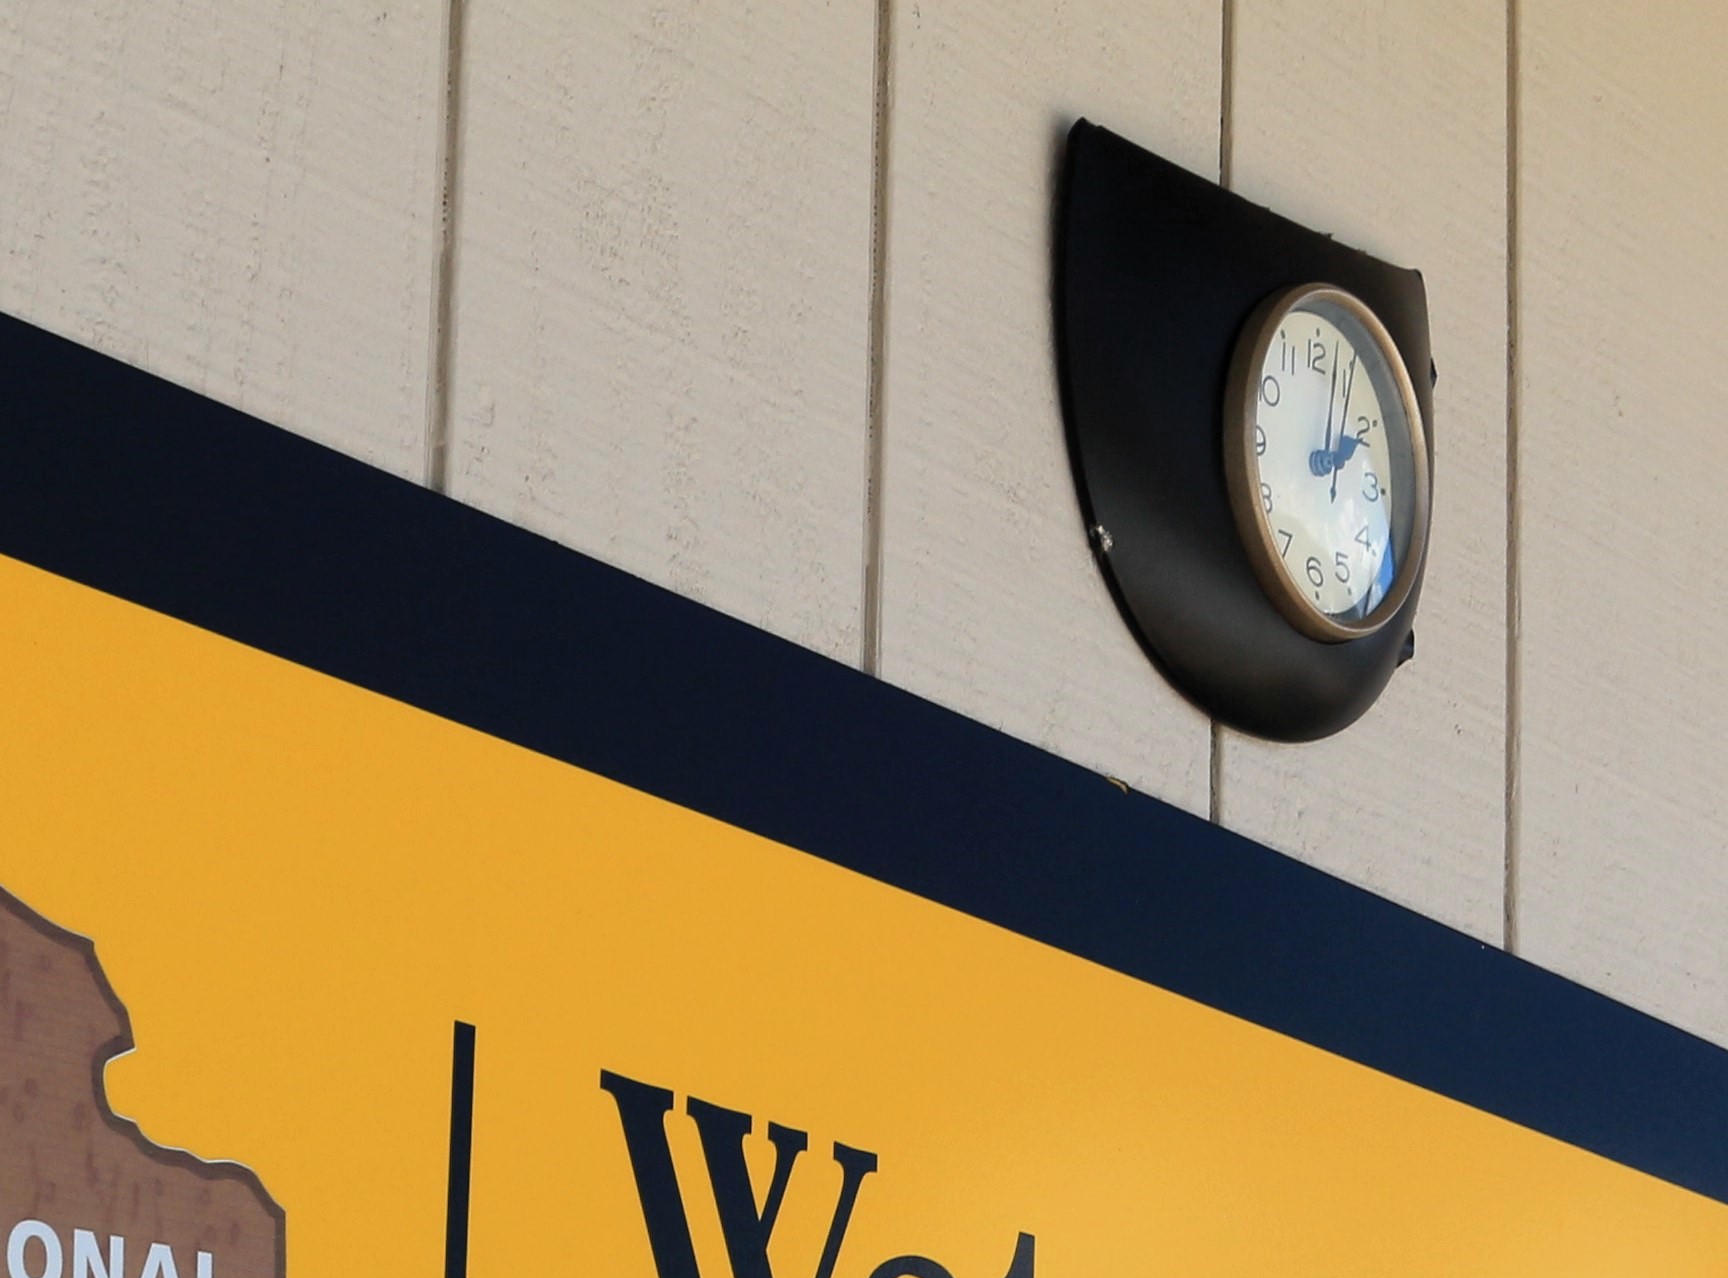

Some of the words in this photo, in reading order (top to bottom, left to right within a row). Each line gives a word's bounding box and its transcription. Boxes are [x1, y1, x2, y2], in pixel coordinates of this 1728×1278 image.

[1281, 341, 1295, 376] 11
[1307, 338, 1326, 375] 12
[1356, 415, 1370, 448] 2
[1362, 471, 1379, 502] 3
[1278, 528, 1293, 559] 7
[1355, 525, 1372, 553] 4
[1306, 556, 1324, 587] 6
[1335, 551, 1351, 583] 5
